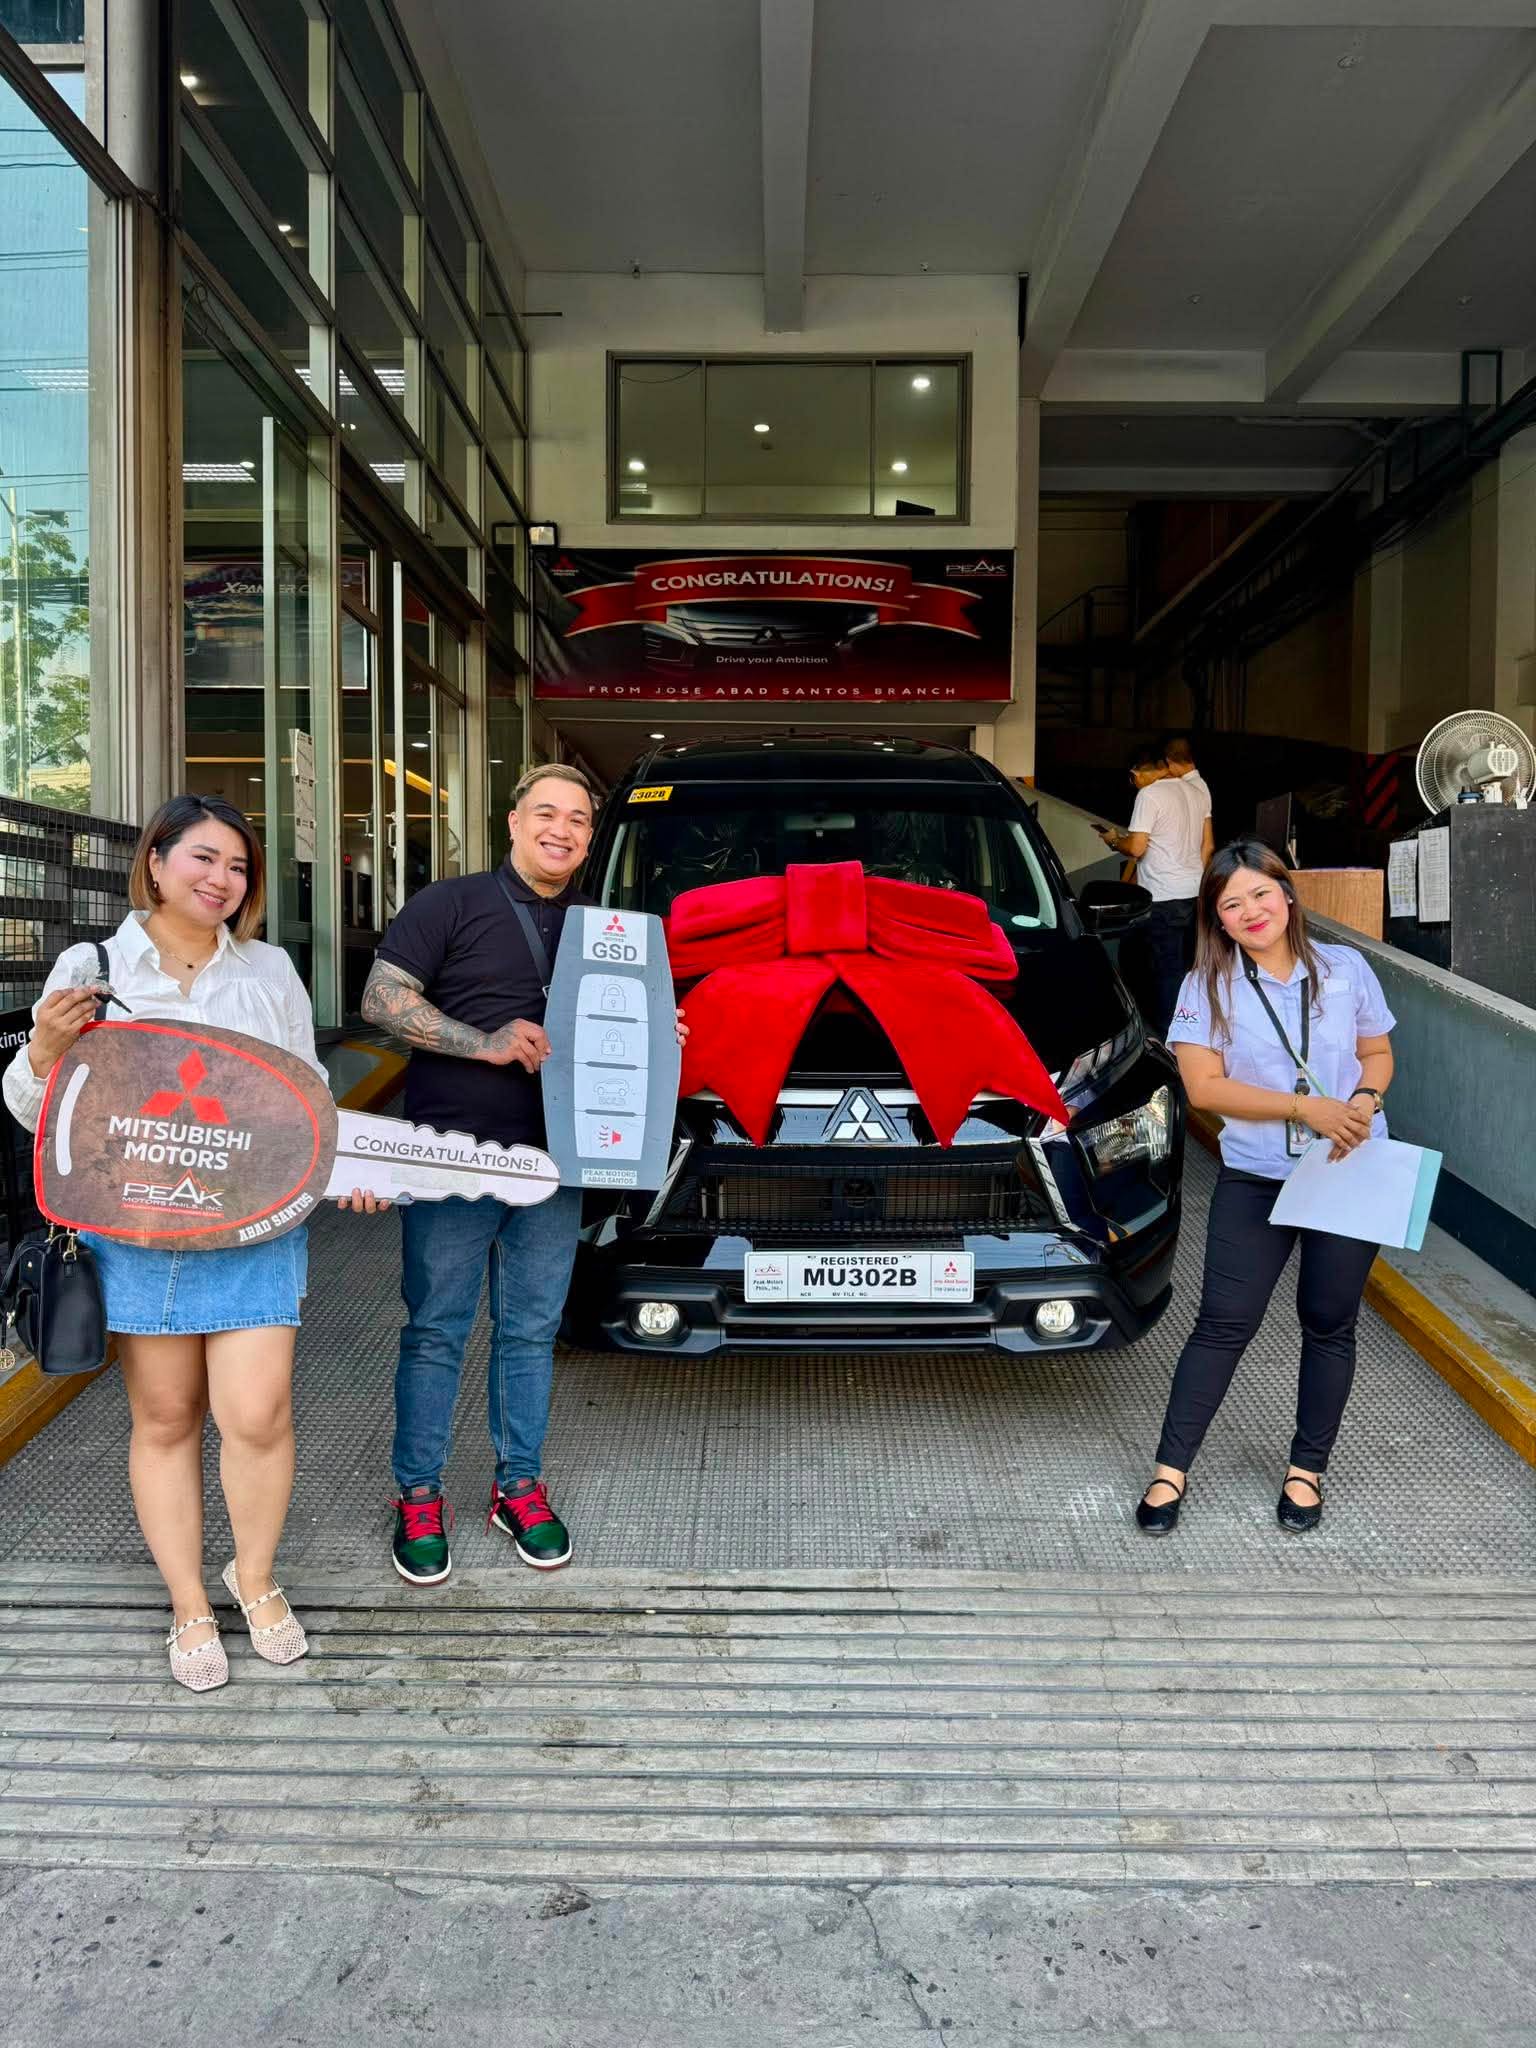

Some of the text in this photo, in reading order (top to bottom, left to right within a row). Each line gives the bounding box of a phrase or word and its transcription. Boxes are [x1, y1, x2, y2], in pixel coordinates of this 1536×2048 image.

[946, 560, 1007, 573] PEAK
[220, 581, 296, 594] XPANER
[650, 571, 895, 593] CONGRATULATIONS!
[716, 656, 829, 665] Drive your Ambition
[589, 686, 956, 695] FROM JOSE ABAD SANTOS BRANCH
[592, 941, 638, 962] GSD
[108, 1115, 253, 1151] MITSUBISHI
[124, 1140, 230, 1171] MOTORS
[353, 1135, 540, 1172] CONGRATULATIONS!
[122, 1176, 224, 1206] PEAK
[121, 1197, 167, 1207] MOTORS
[238, 1192, 314, 1242] ABAD SANTOS
[820, 1256, 899, 1266] REGISTERED
[803, 1268, 917, 1287] MU302B
